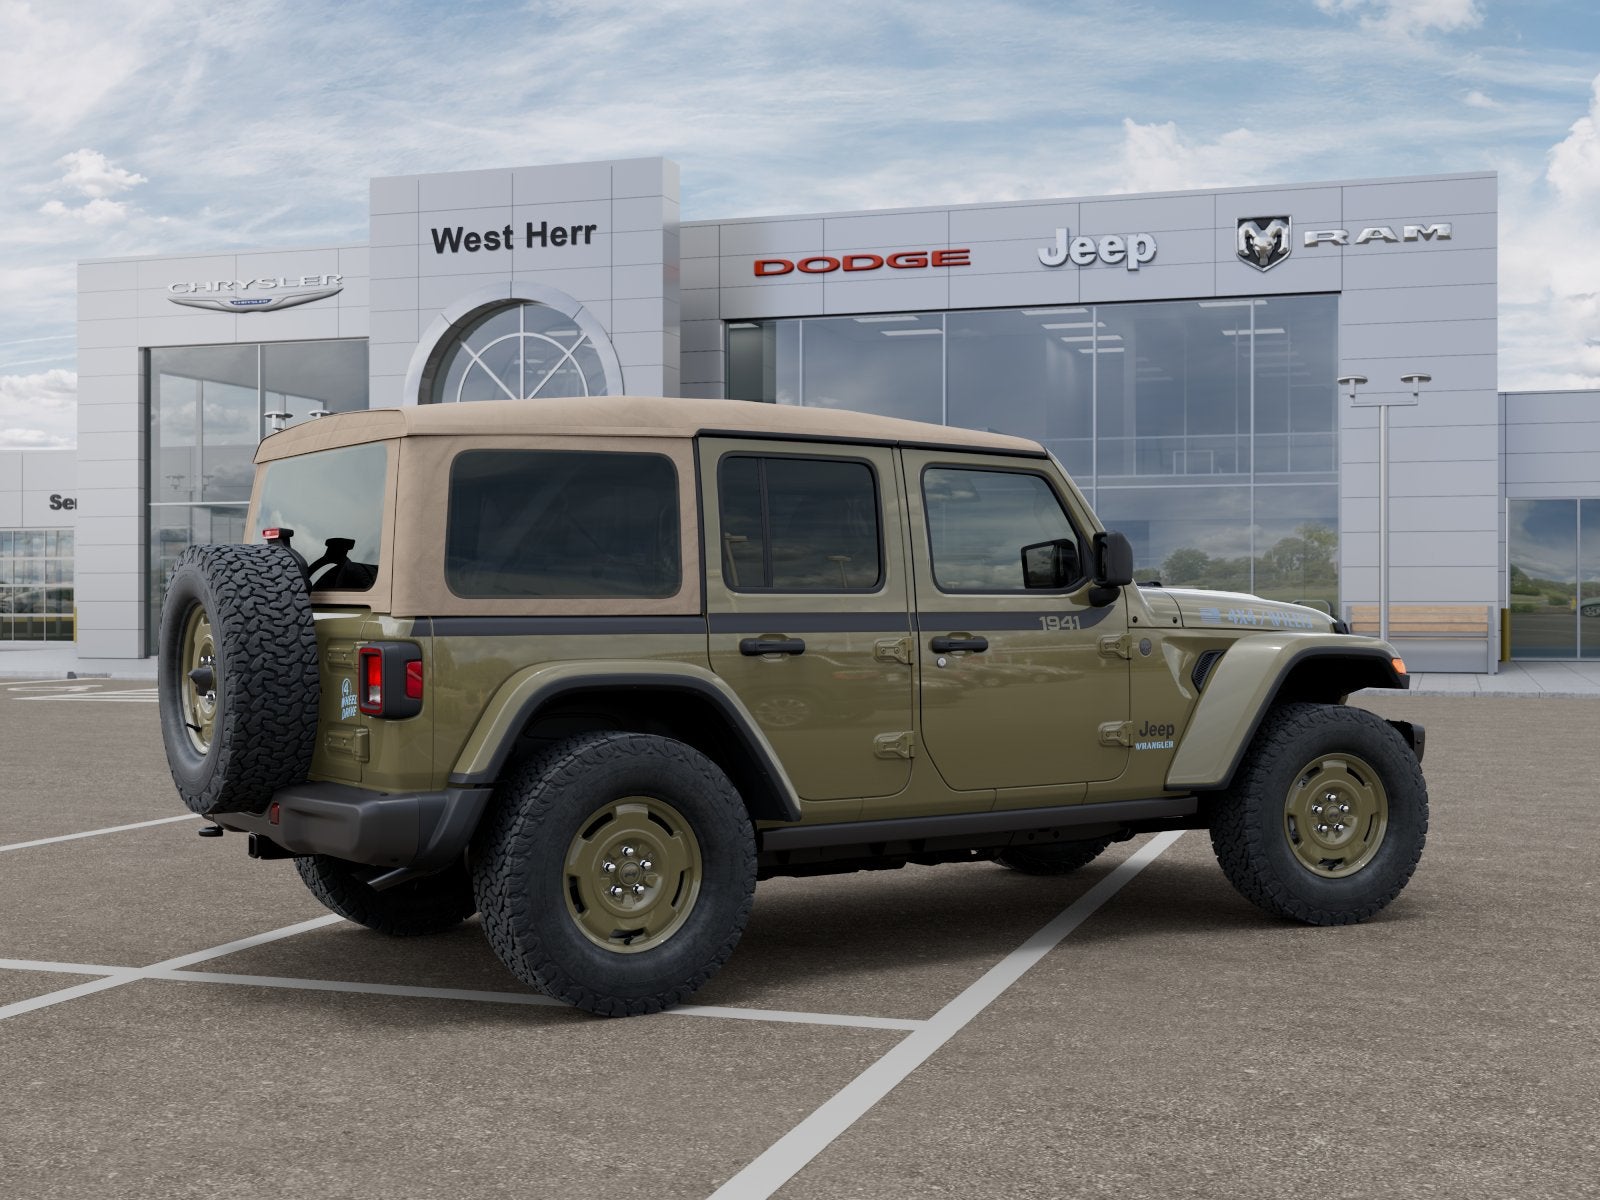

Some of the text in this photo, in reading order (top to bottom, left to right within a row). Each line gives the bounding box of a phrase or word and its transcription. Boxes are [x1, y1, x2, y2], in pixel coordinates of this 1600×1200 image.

[431, 221, 597, 254] West Herr
[1304, 223, 1452, 248] RAM
[1037, 227, 1157, 271] Jeep
[754, 249, 971, 276] DODGE
[167, 273, 344, 294] CHRYSLER
[49, 493, 78, 511] Se
[1039, 615, 1081, 631] 1941
[1139, 720, 1175, 739] Jeep
[1135, 740, 1174, 750] WRANGLER
